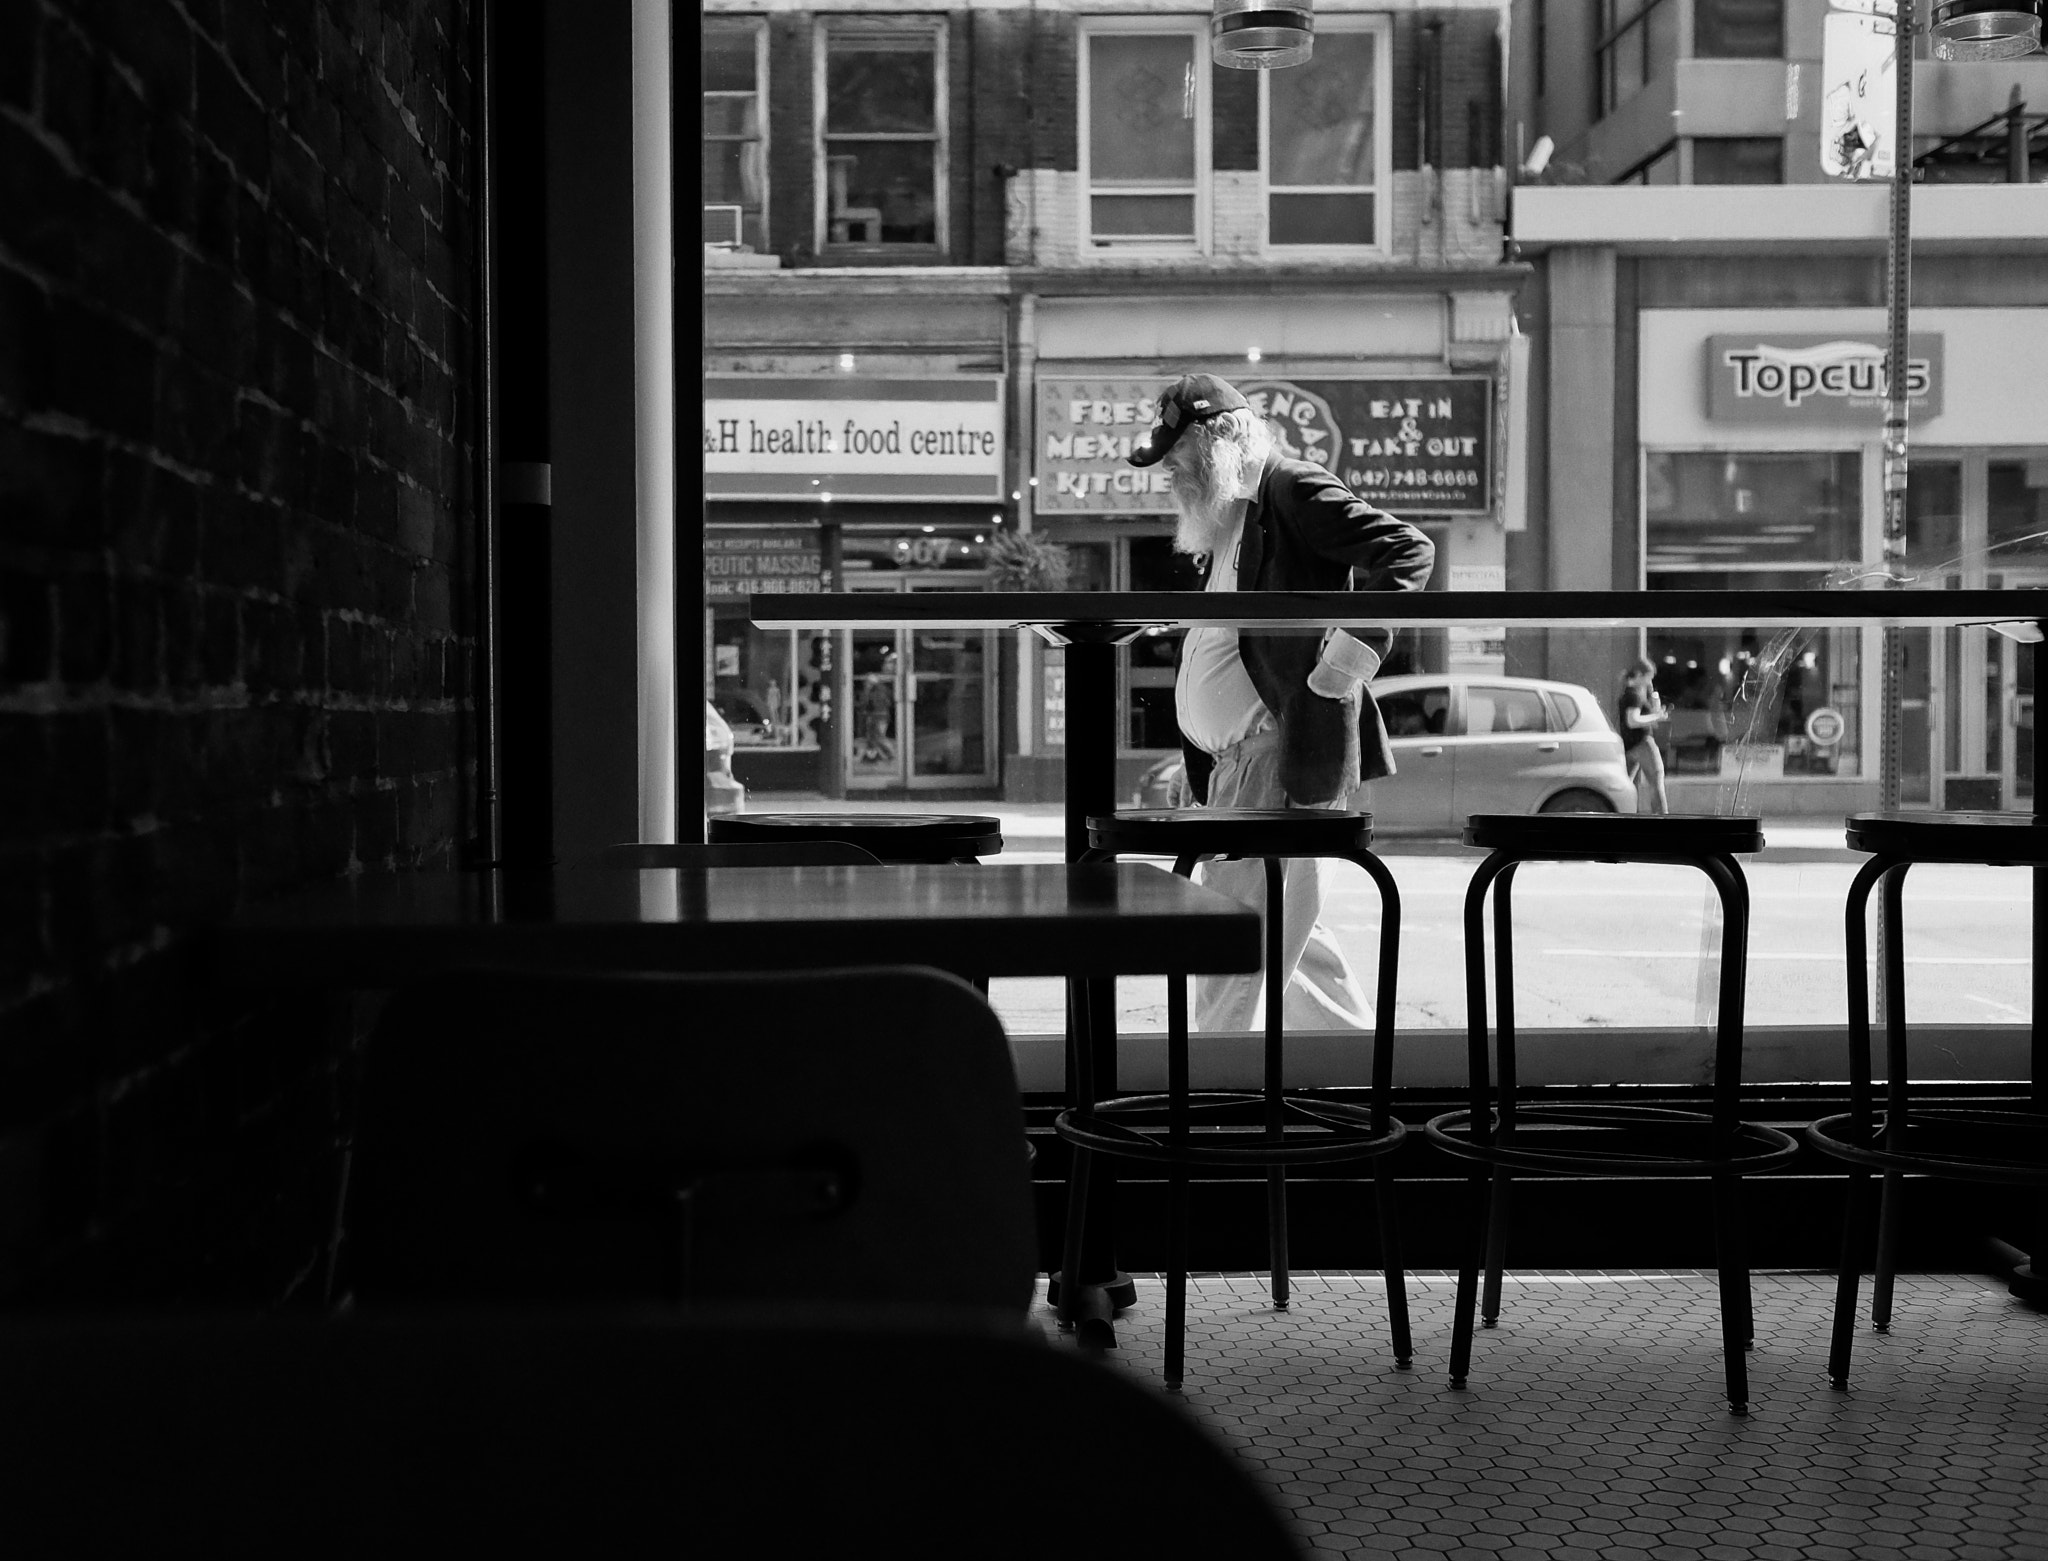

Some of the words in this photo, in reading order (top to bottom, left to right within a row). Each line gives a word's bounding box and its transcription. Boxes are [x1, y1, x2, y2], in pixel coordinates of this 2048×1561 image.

[1069, 398, 1161, 425] FRES
[1369, 399, 1422, 419] EAT
[1428, 398, 1452, 420] IN
[750, 419, 831, 454] health
[843, 419, 901, 454] food
[910, 423, 995, 456] centre
[1398, 416, 1424, 443] &
[1350, 436, 1421, 457] TAKE
[1426, 436, 1478, 458] OUT
[1056, 469, 1171, 494] KITCHE
[756, 554, 821, 575] MASSAG
